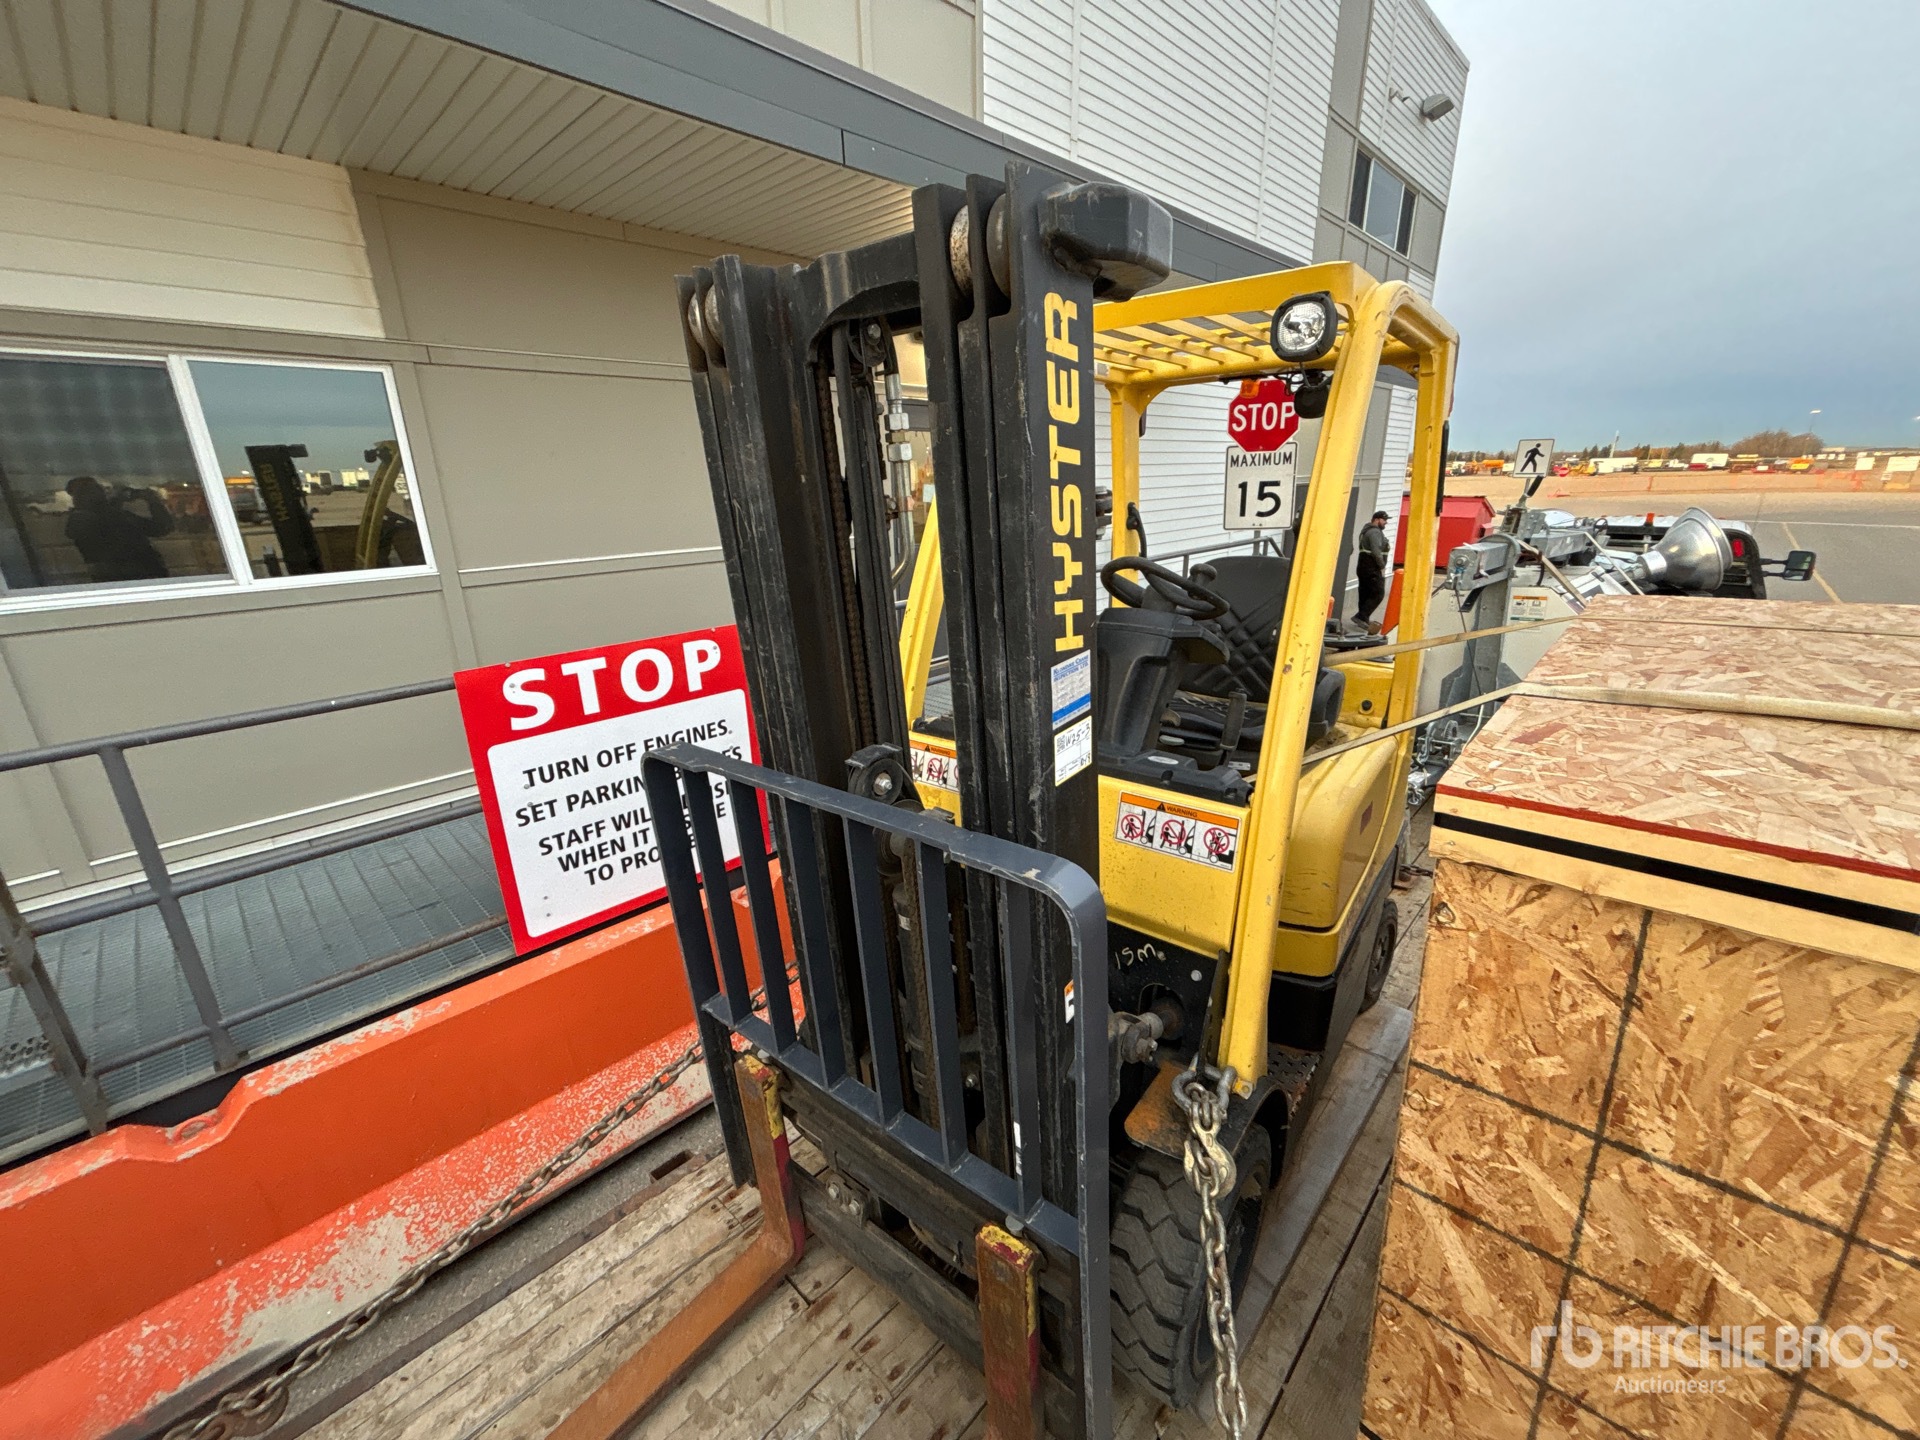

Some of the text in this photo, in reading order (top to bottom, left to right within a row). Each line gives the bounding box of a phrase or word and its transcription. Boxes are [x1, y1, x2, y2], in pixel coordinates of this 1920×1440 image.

[1231, 401, 1297, 432] STOP
[1044, 292, 1084, 652] HYSTER
[1230, 452, 1293, 468] MAXIMUM
[1238, 480, 1282, 518] 15
[502, 639, 721, 731] STOP
[523, 755, 589, 788] TURN
[596, 743, 637, 769] OFF
[515, 800, 557, 827] SET
[566, 775, 646, 813] PARKIN
[1167, 805, 1198, 818] WARNING
[538, 807, 653, 856] STAFF WIL
[557, 834, 626, 873] WHEN
[632, 827, 650, 846] IT
[584, 863, 614, 887] TO
